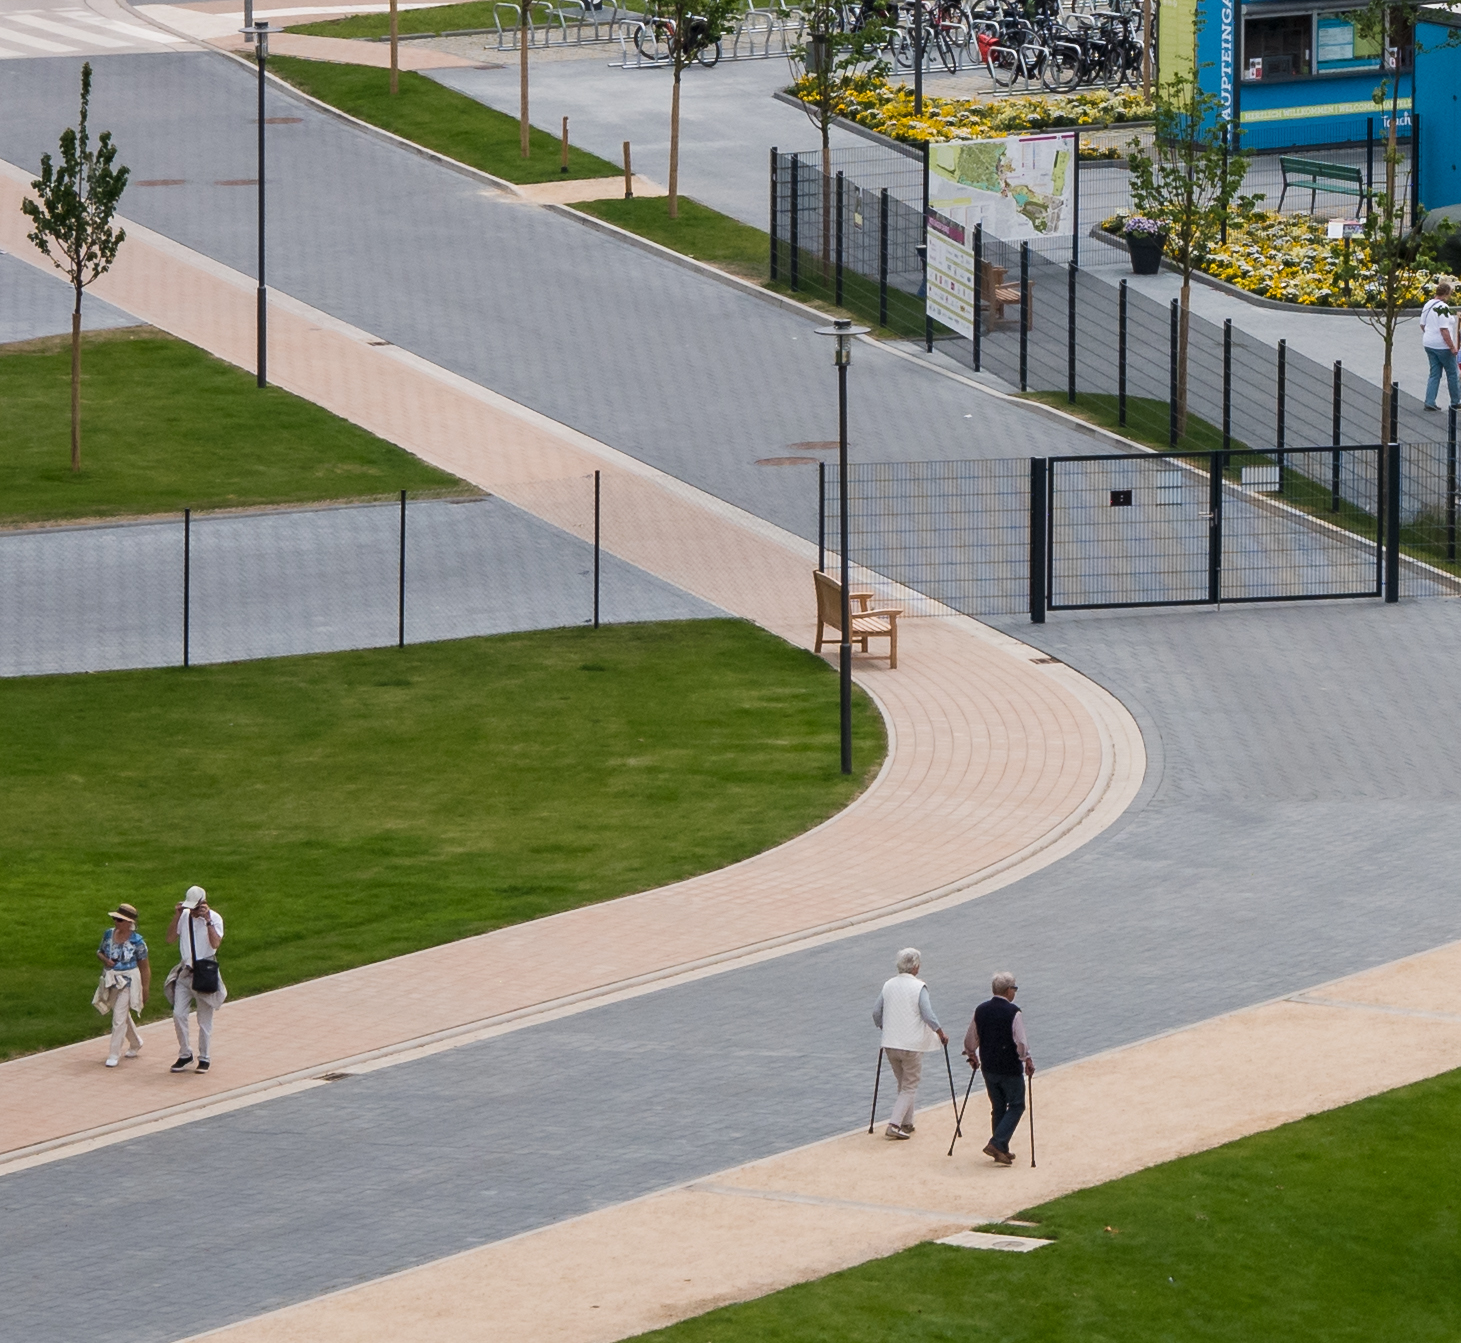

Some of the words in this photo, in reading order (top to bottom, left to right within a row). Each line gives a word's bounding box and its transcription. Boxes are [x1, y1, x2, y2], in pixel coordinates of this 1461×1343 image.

[1245, 111, 1282, 120] HERZLICH
[1283, 106, 1334, 117] WILLKOMMEN
[1338, 102, 1375, 113] WELCOME
